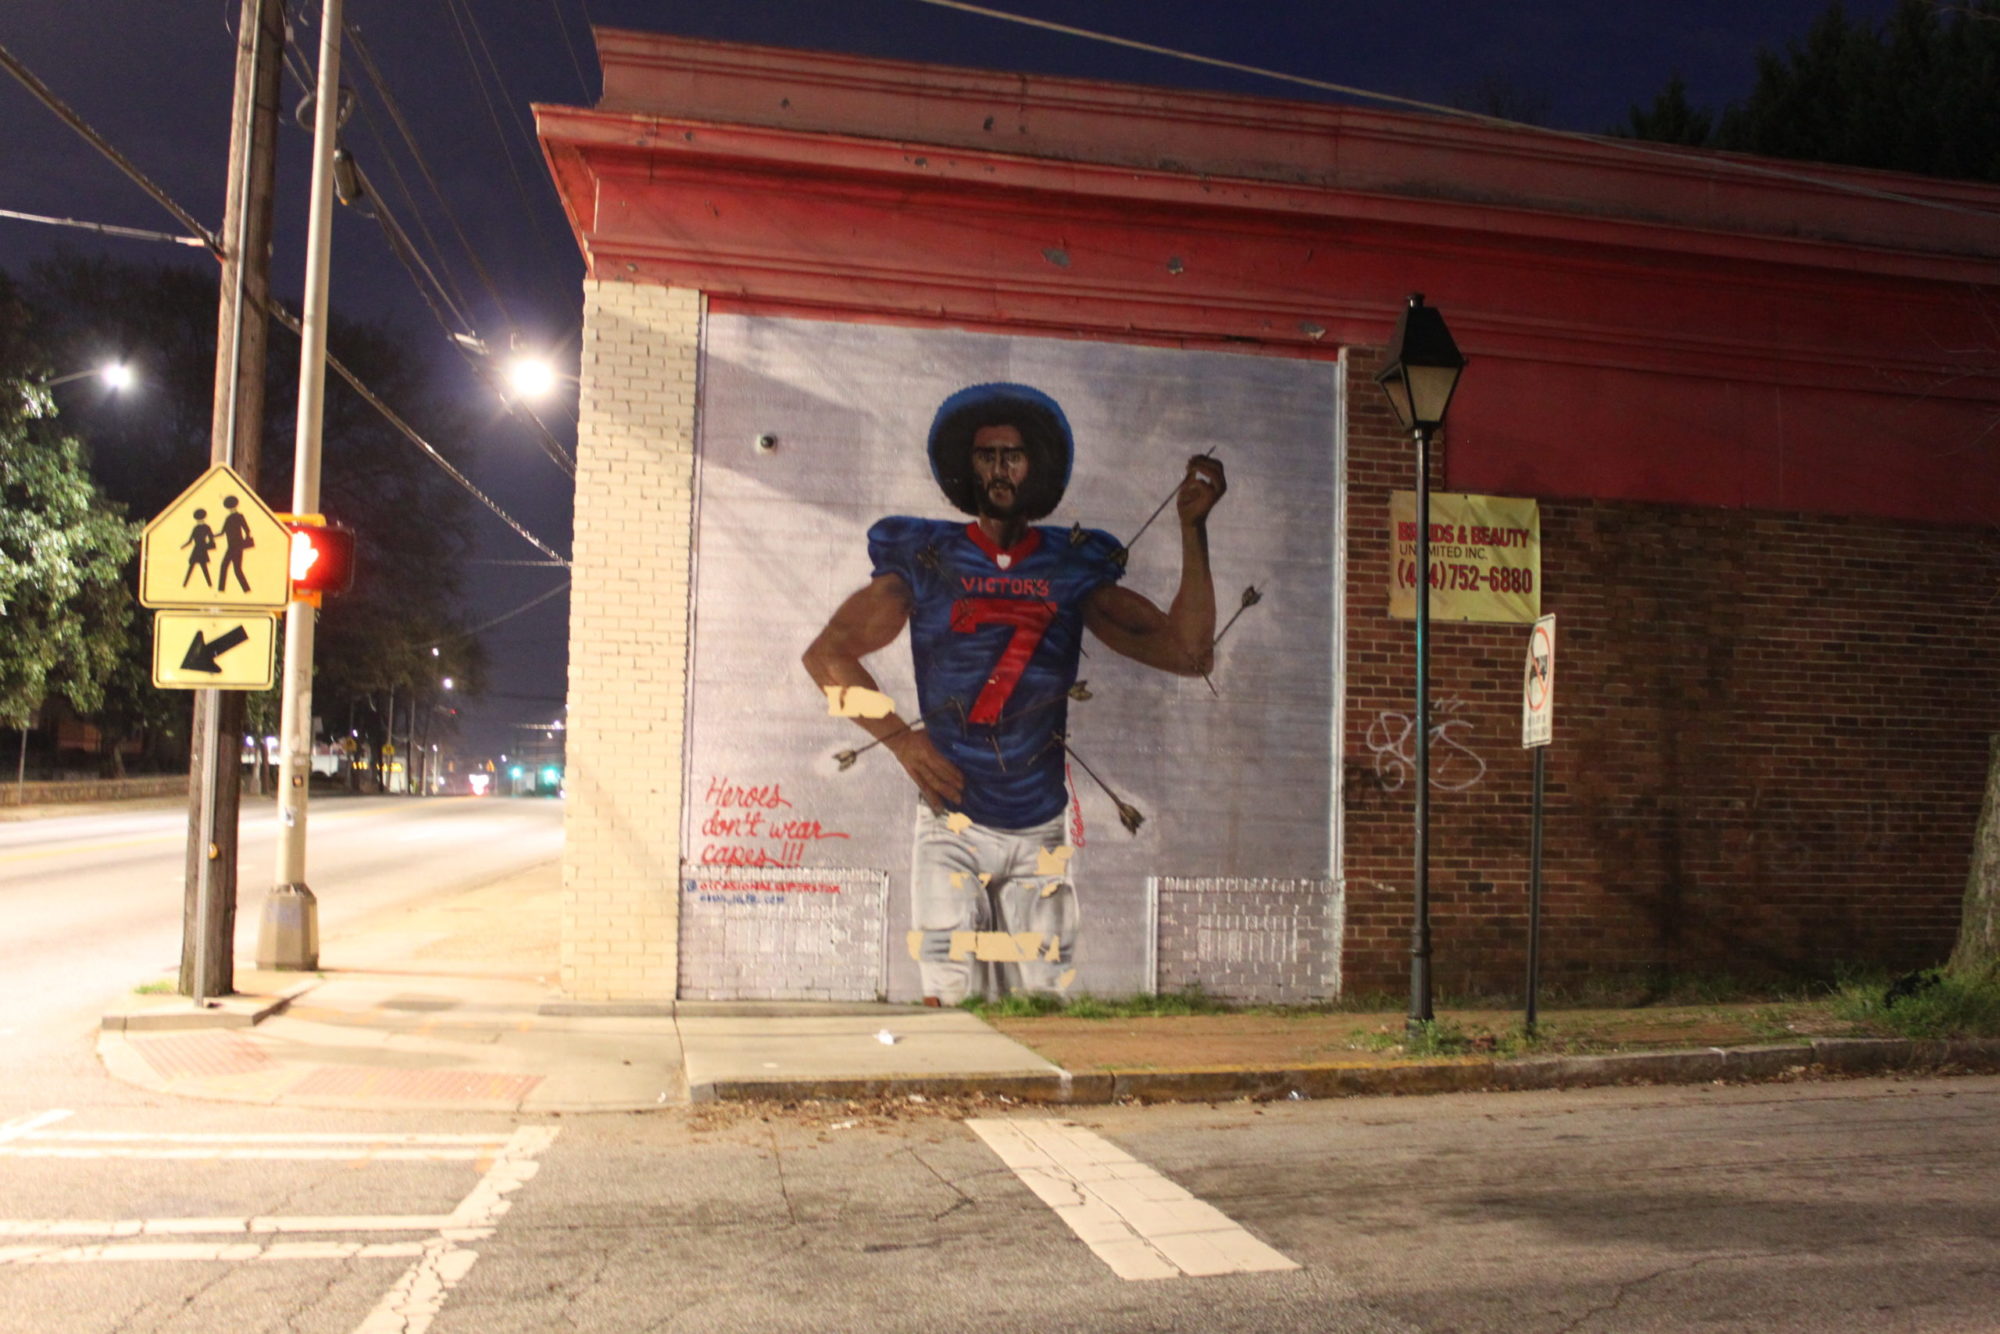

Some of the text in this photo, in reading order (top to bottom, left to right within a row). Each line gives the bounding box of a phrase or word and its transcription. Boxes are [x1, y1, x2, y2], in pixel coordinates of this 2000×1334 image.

[1398, 521, 1530, 549] BRIDS & BEAUTY
[1400, 543, 1488, 561] UNMITED INC.
[961, 577, 1050, 597] VICTORS
[1397, 558, 1533, 595] (44)752-6880
[951, 598, 1058, 726] 7
[705, 776, 793, 809] Heroes
[702, 809, 852, 840] don't wear
